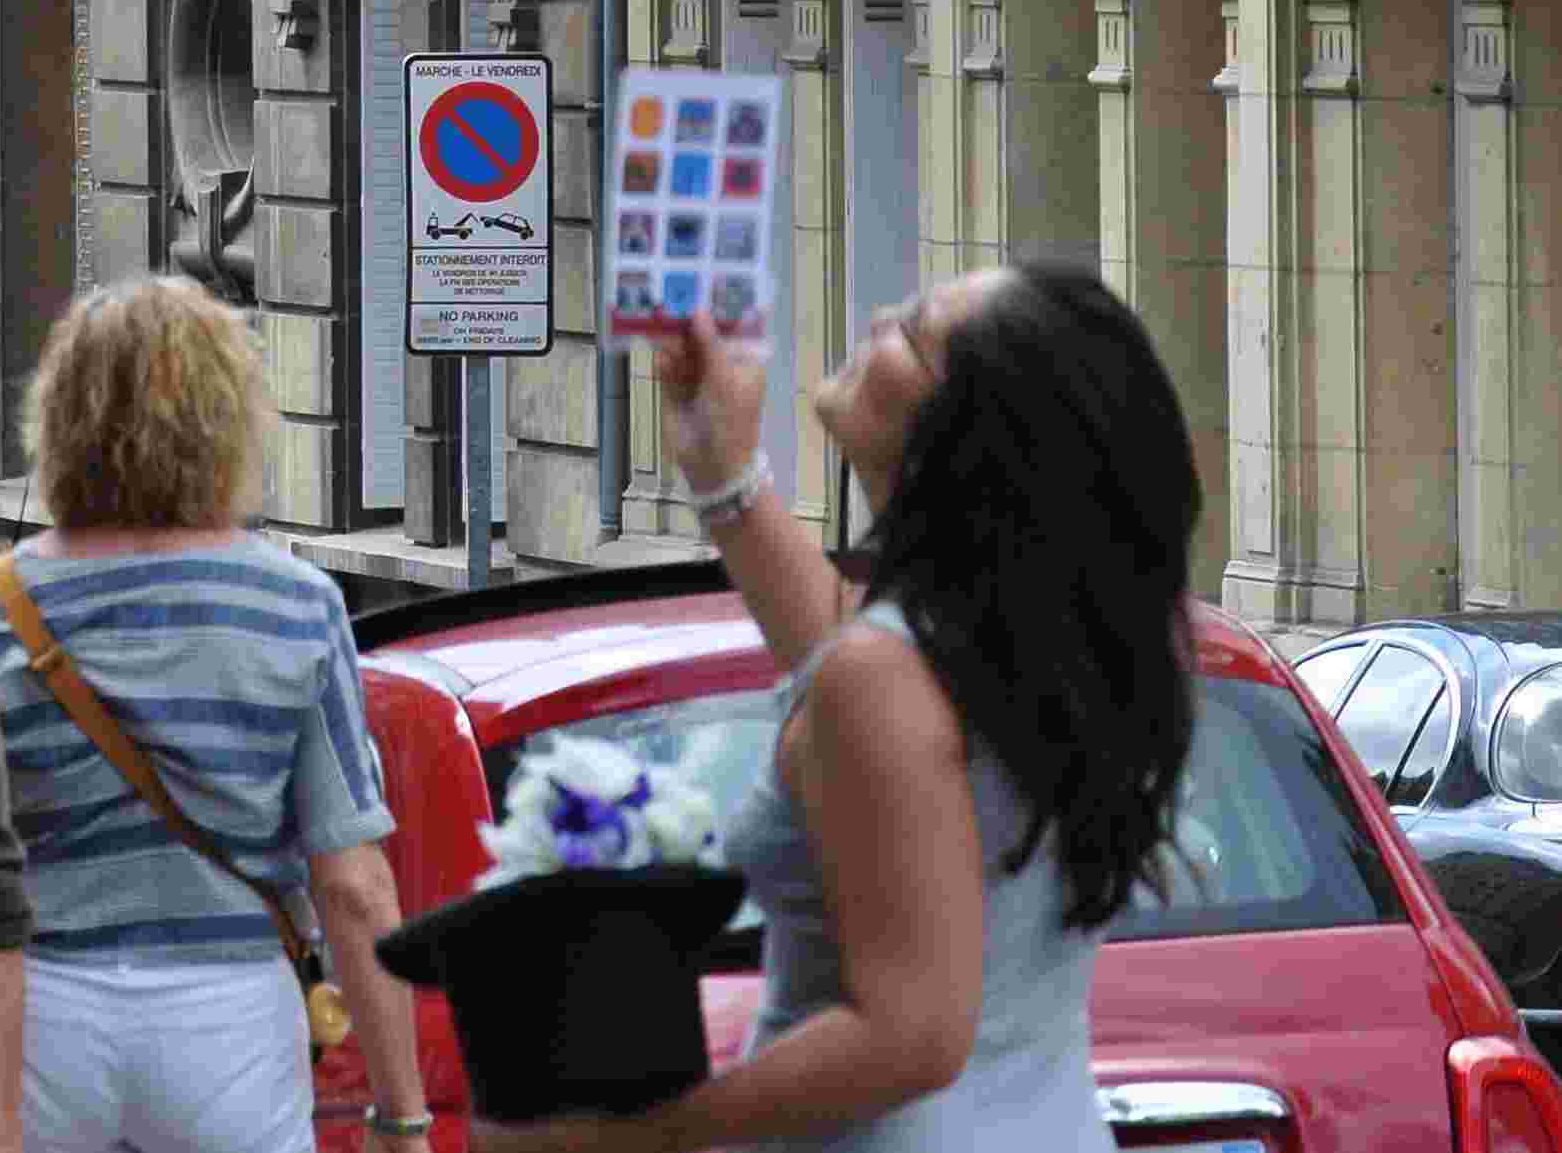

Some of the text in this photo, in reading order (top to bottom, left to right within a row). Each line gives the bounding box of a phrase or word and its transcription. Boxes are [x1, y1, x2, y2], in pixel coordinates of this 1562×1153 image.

[415, 65, 463, 77] MARCHE
[471, 65, 486, 77] LE
[415, 254, 546, 265] STATIONNEMENT INTERDIT
[439, 310, 519, 321] NO PARKING
